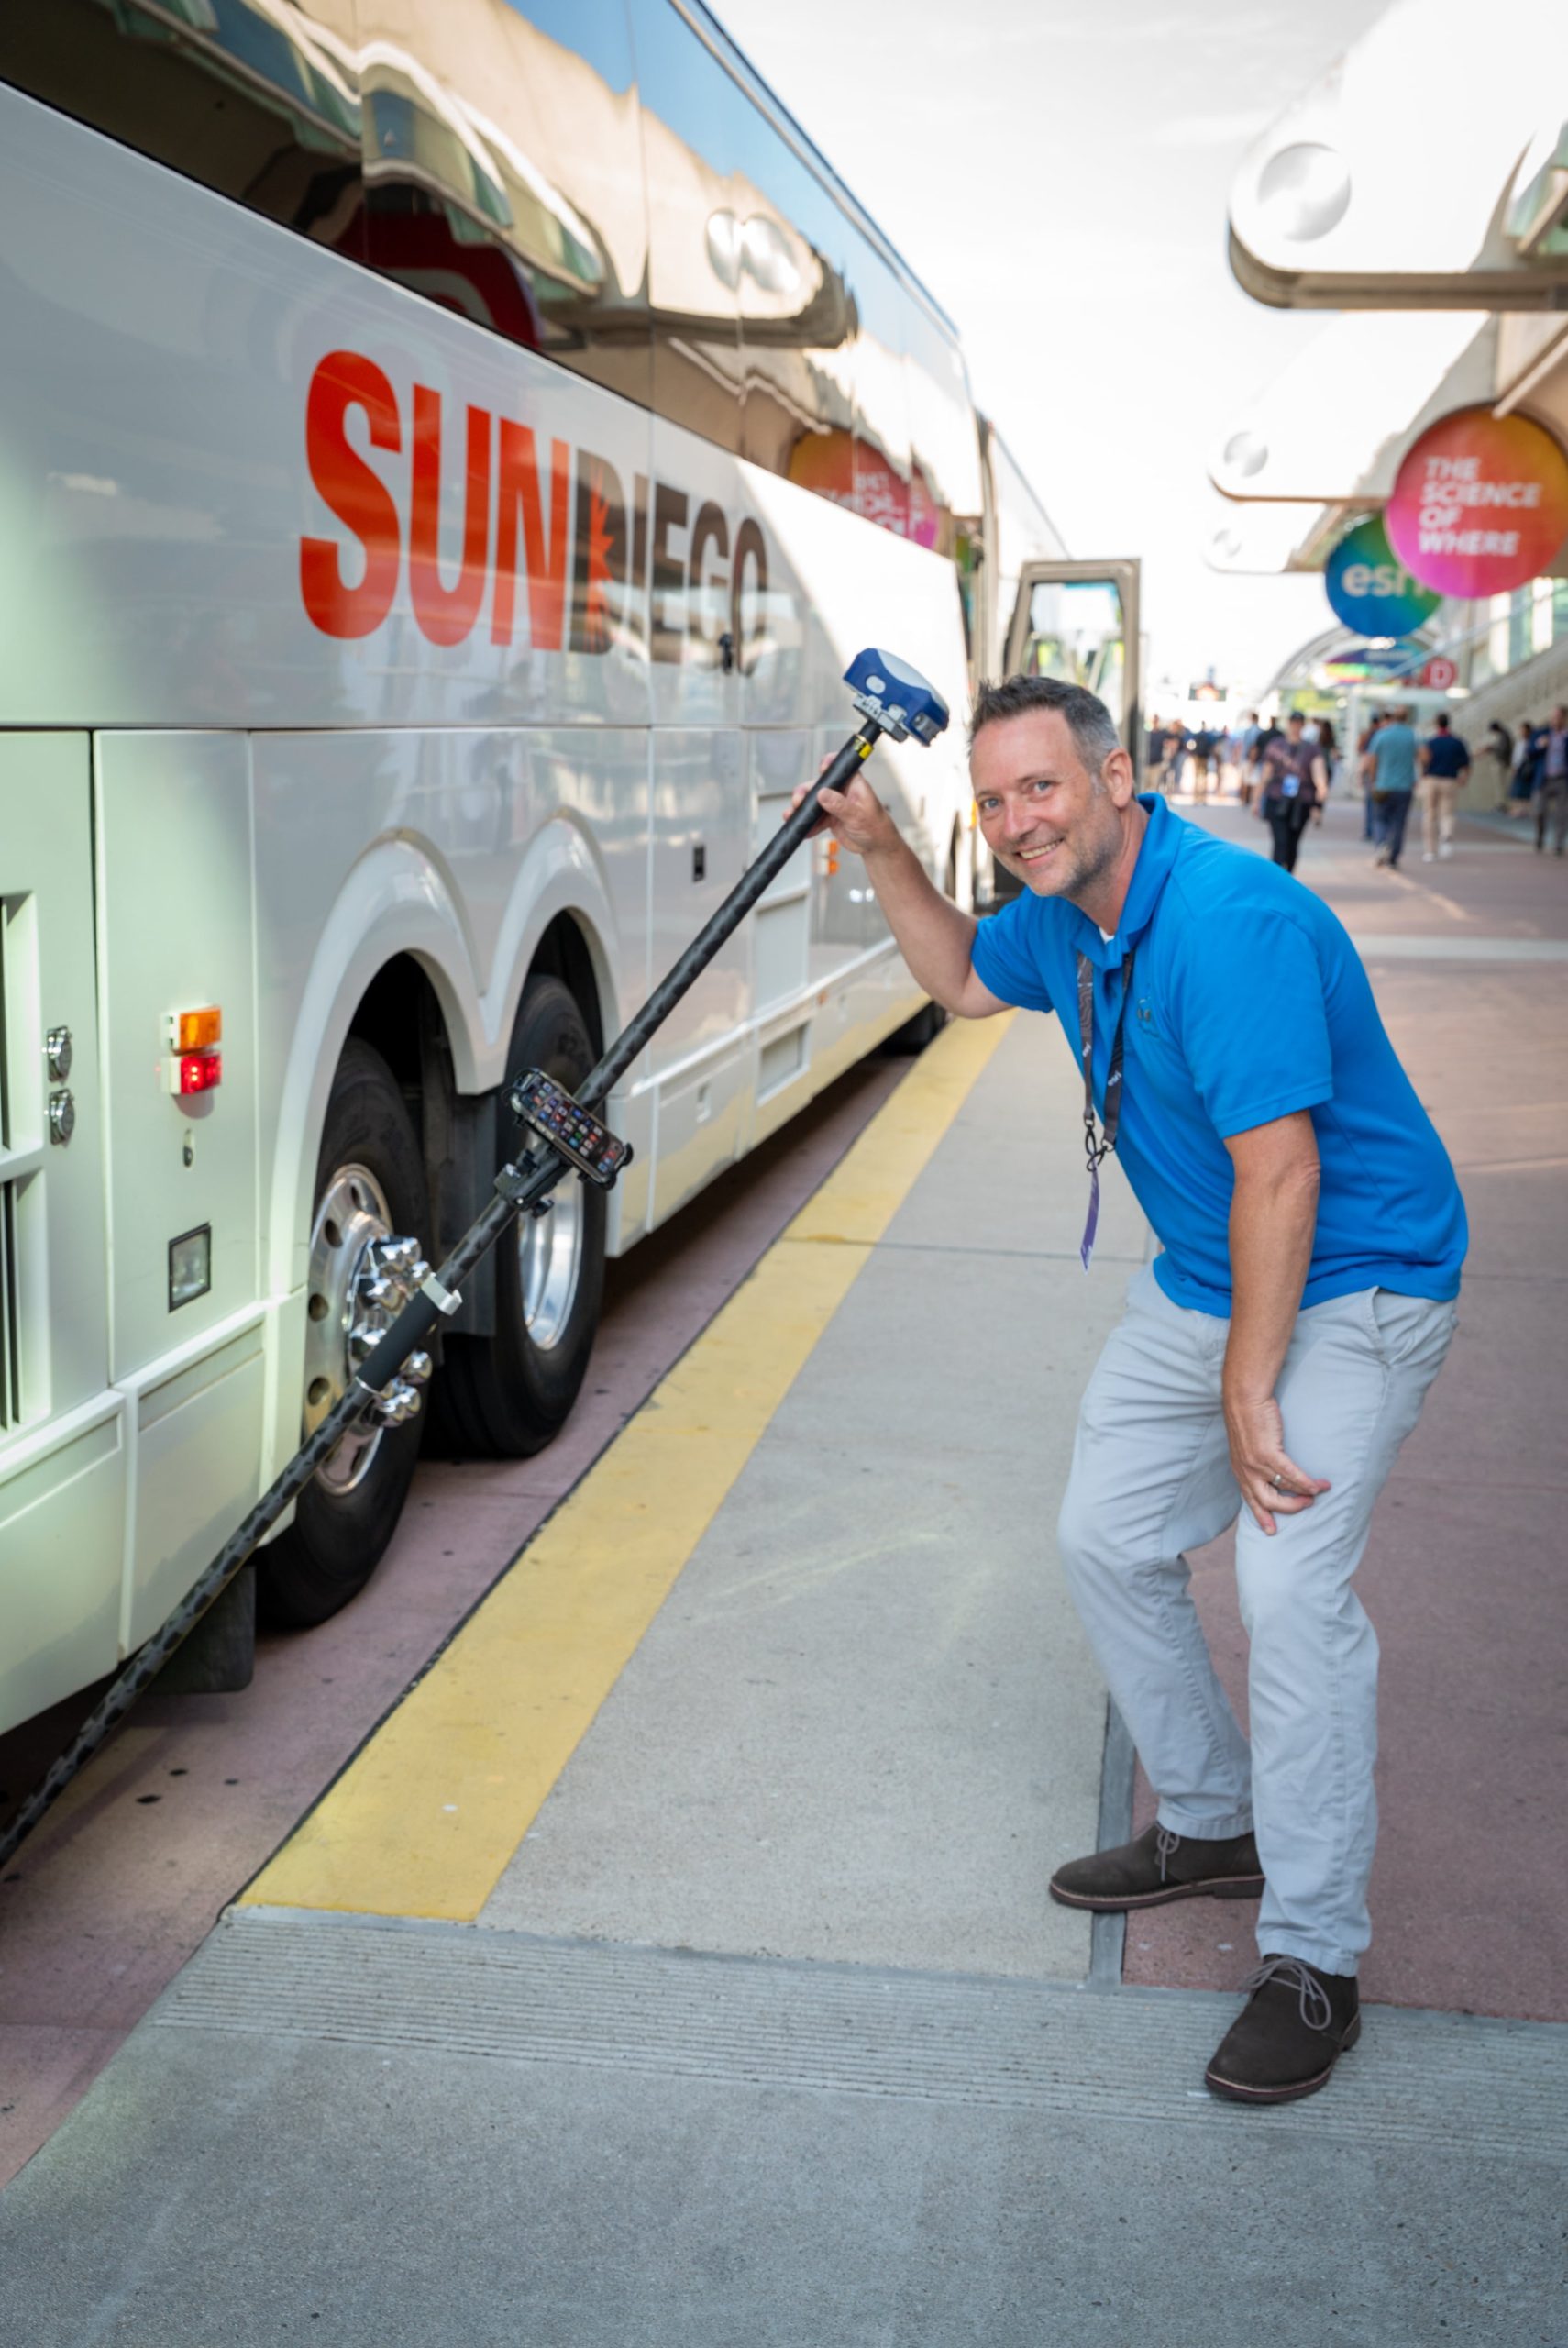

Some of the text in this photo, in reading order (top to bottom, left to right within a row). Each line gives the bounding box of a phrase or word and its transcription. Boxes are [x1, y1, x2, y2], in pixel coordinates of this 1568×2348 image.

[1425, 456, 1481, 480] THE
[1420, 482, 1542, 508] SCIENCE
[1419, 505, 1462, 529] OF
[1418, 531, 1520, 557] WHERE
[1430, 661, 1452, 688] D
